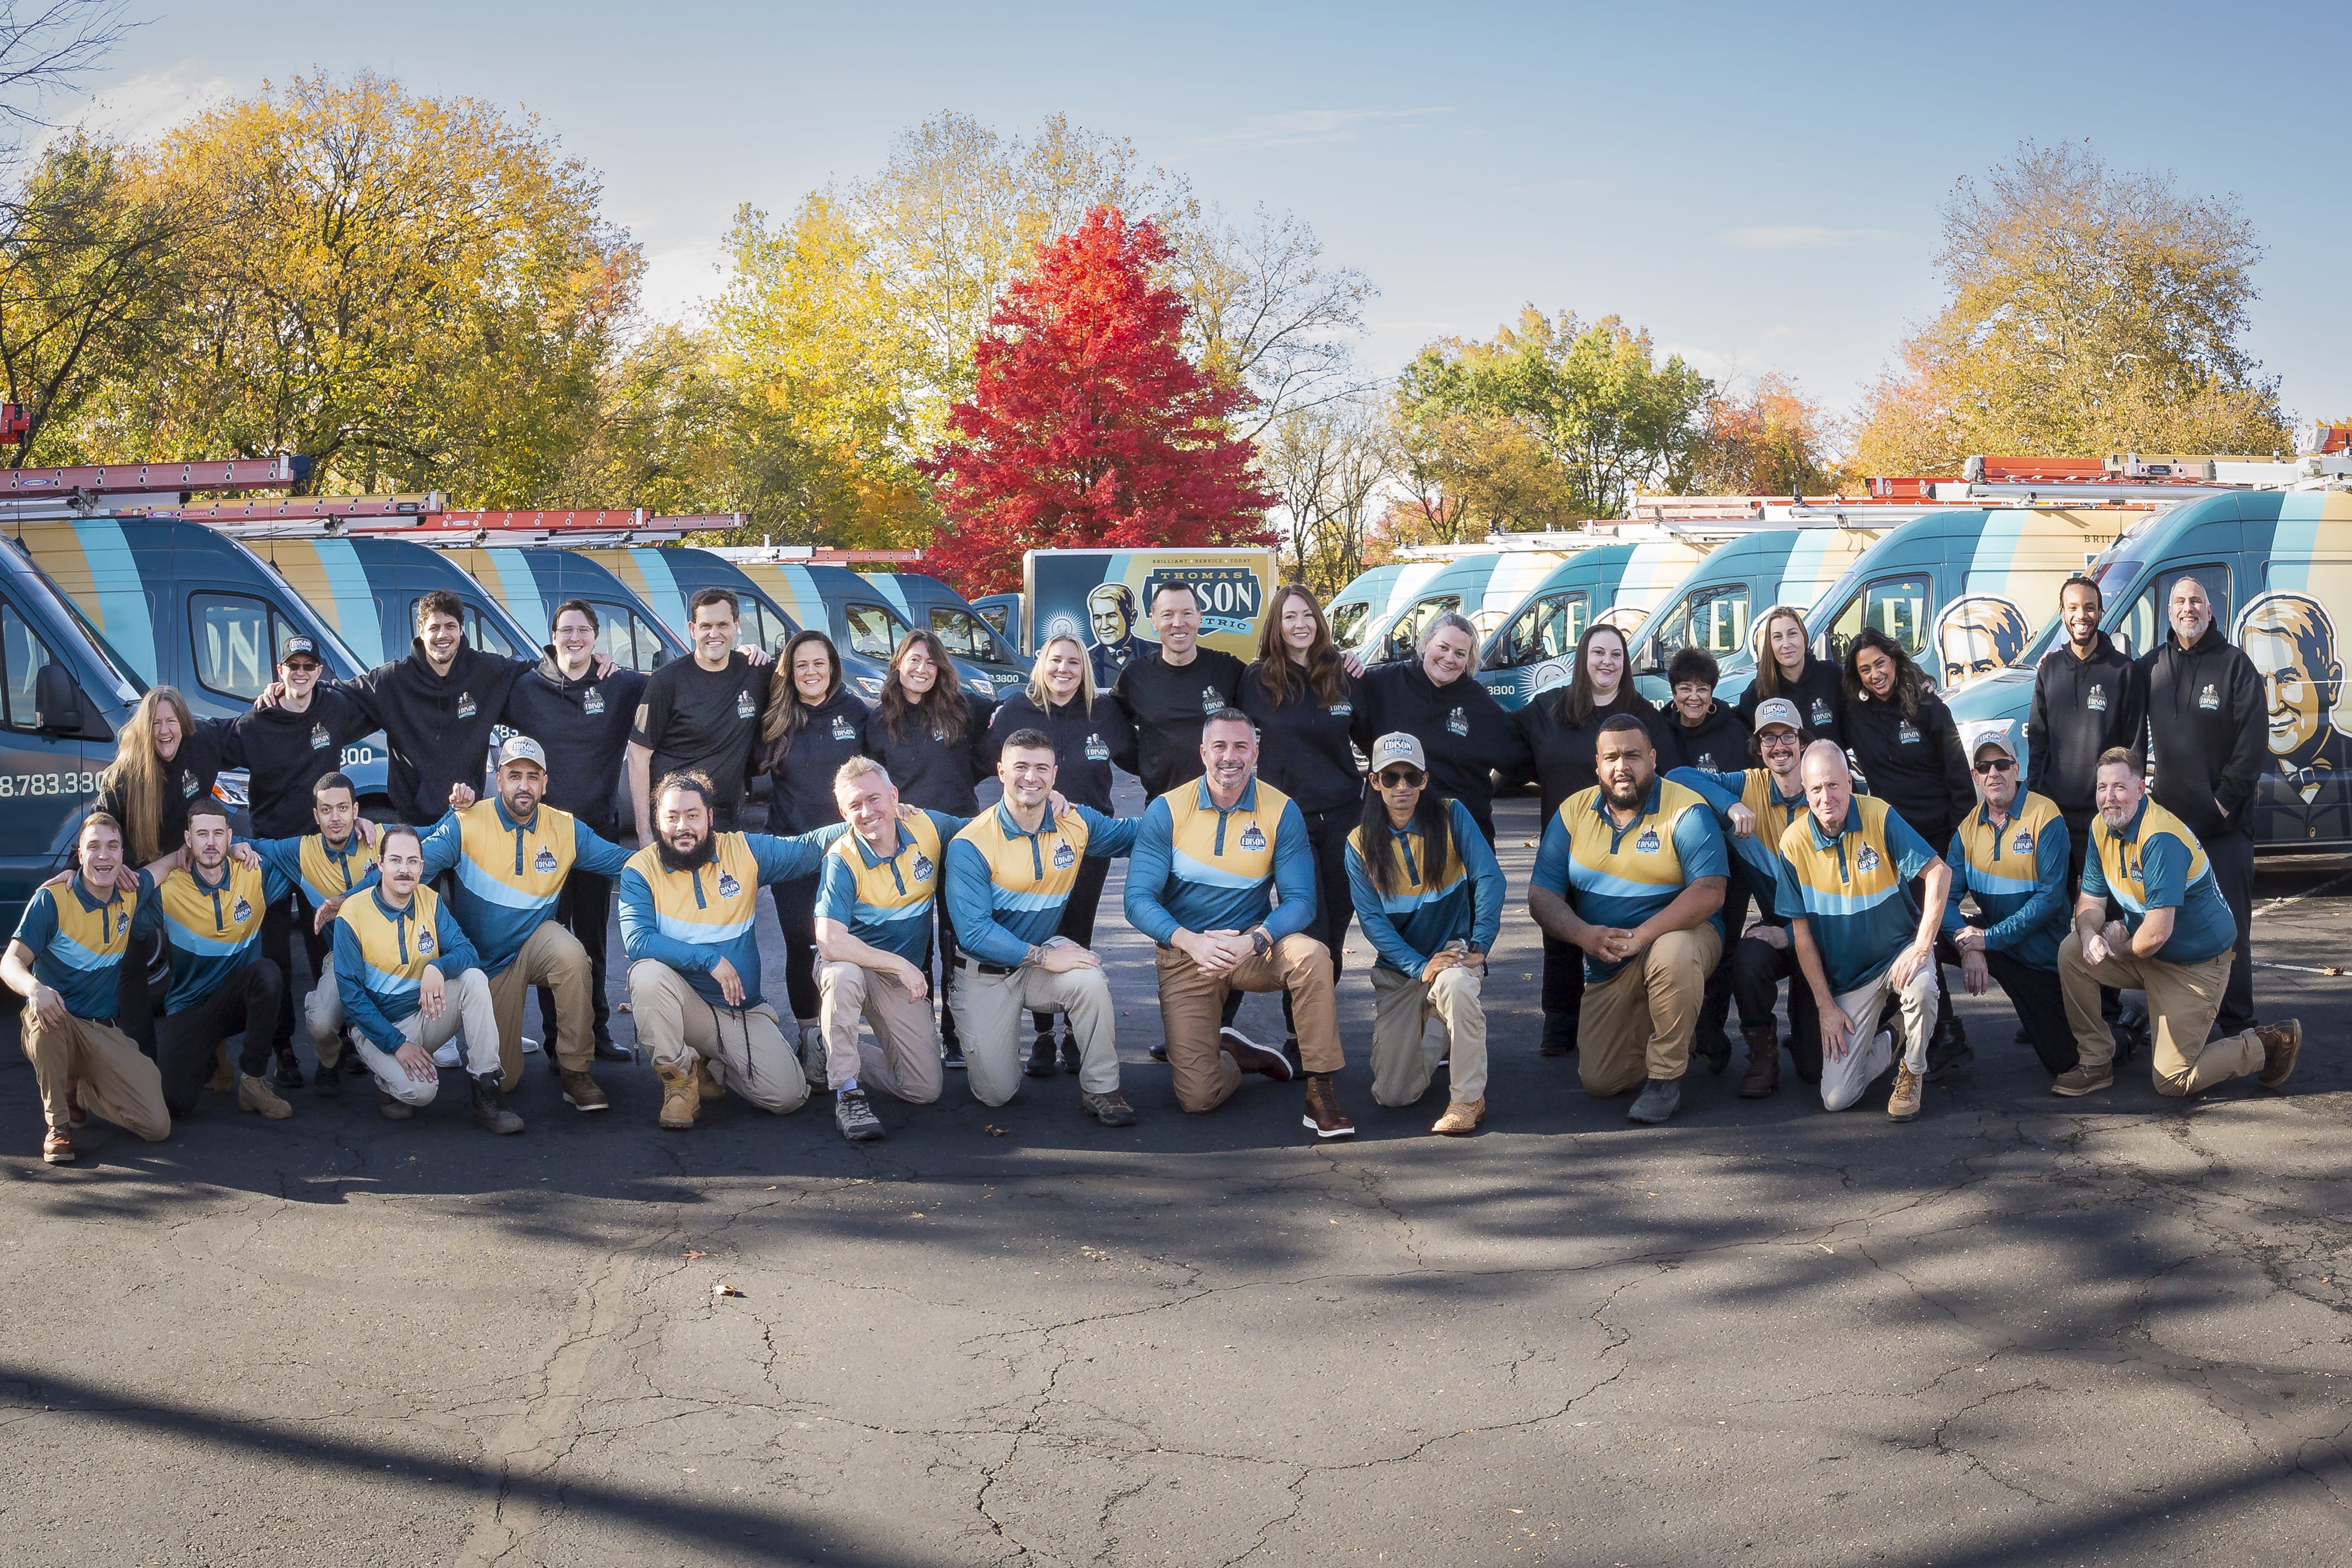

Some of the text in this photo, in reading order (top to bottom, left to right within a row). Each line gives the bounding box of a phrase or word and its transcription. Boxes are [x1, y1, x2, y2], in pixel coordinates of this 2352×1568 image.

[291, 640, 312, 648] EDISON
[1763, 704, 1787, 715] EDISON
[513, 743, 536, 753] EDISON
[1384, 740, 1412, 750] EDISON
[1241, 838, 1265, 846] EDISON
